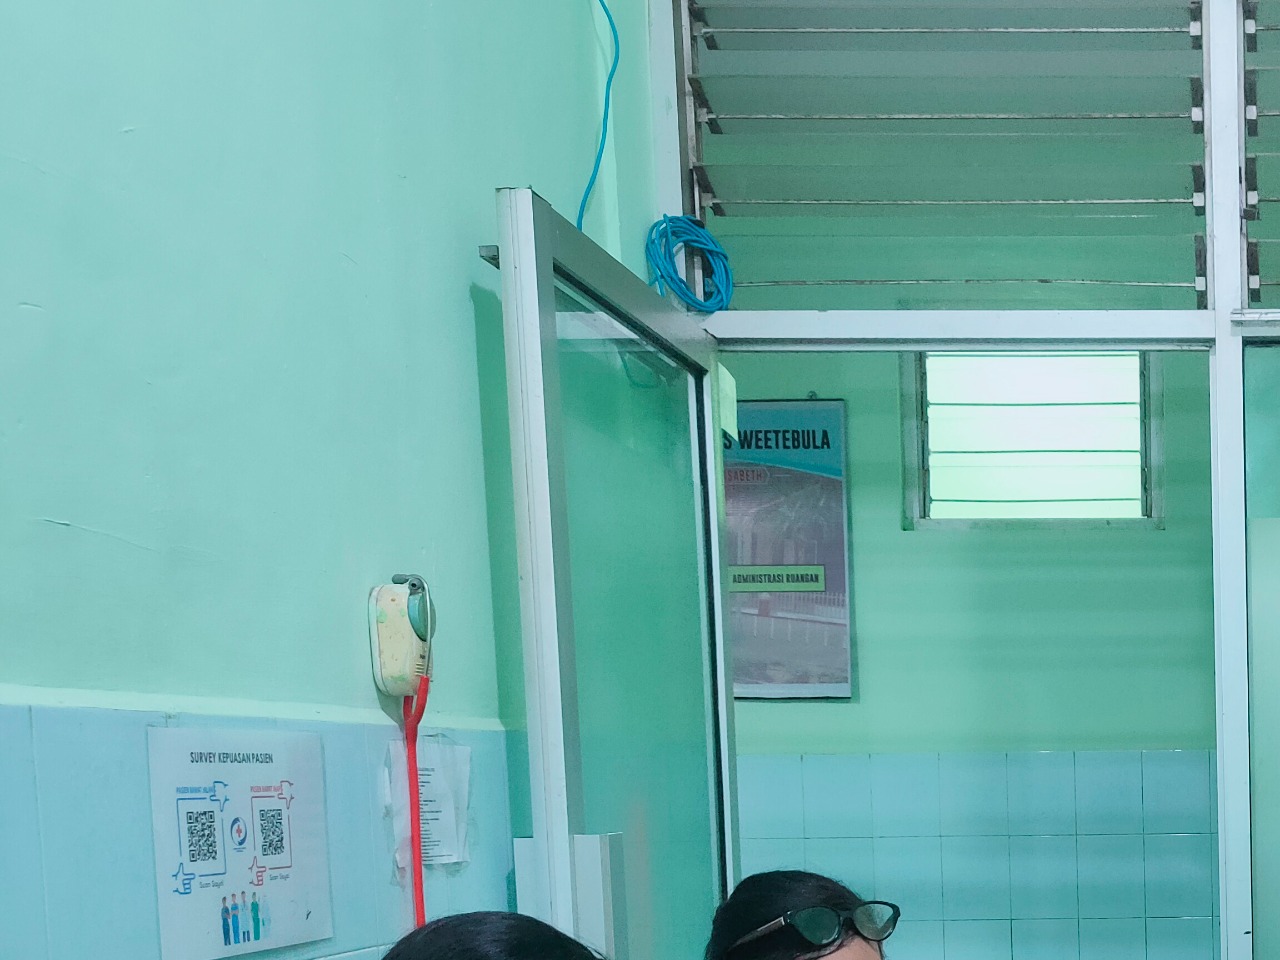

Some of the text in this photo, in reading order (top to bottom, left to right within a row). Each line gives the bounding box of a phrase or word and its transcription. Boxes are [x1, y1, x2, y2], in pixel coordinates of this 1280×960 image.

[738, 429, 831, 450] WEETEBULA
[732, 573, 785, 584] ADMINISTRASI
[190, 751, 274, 764] SURVEY KEPUASAN PASIEN
